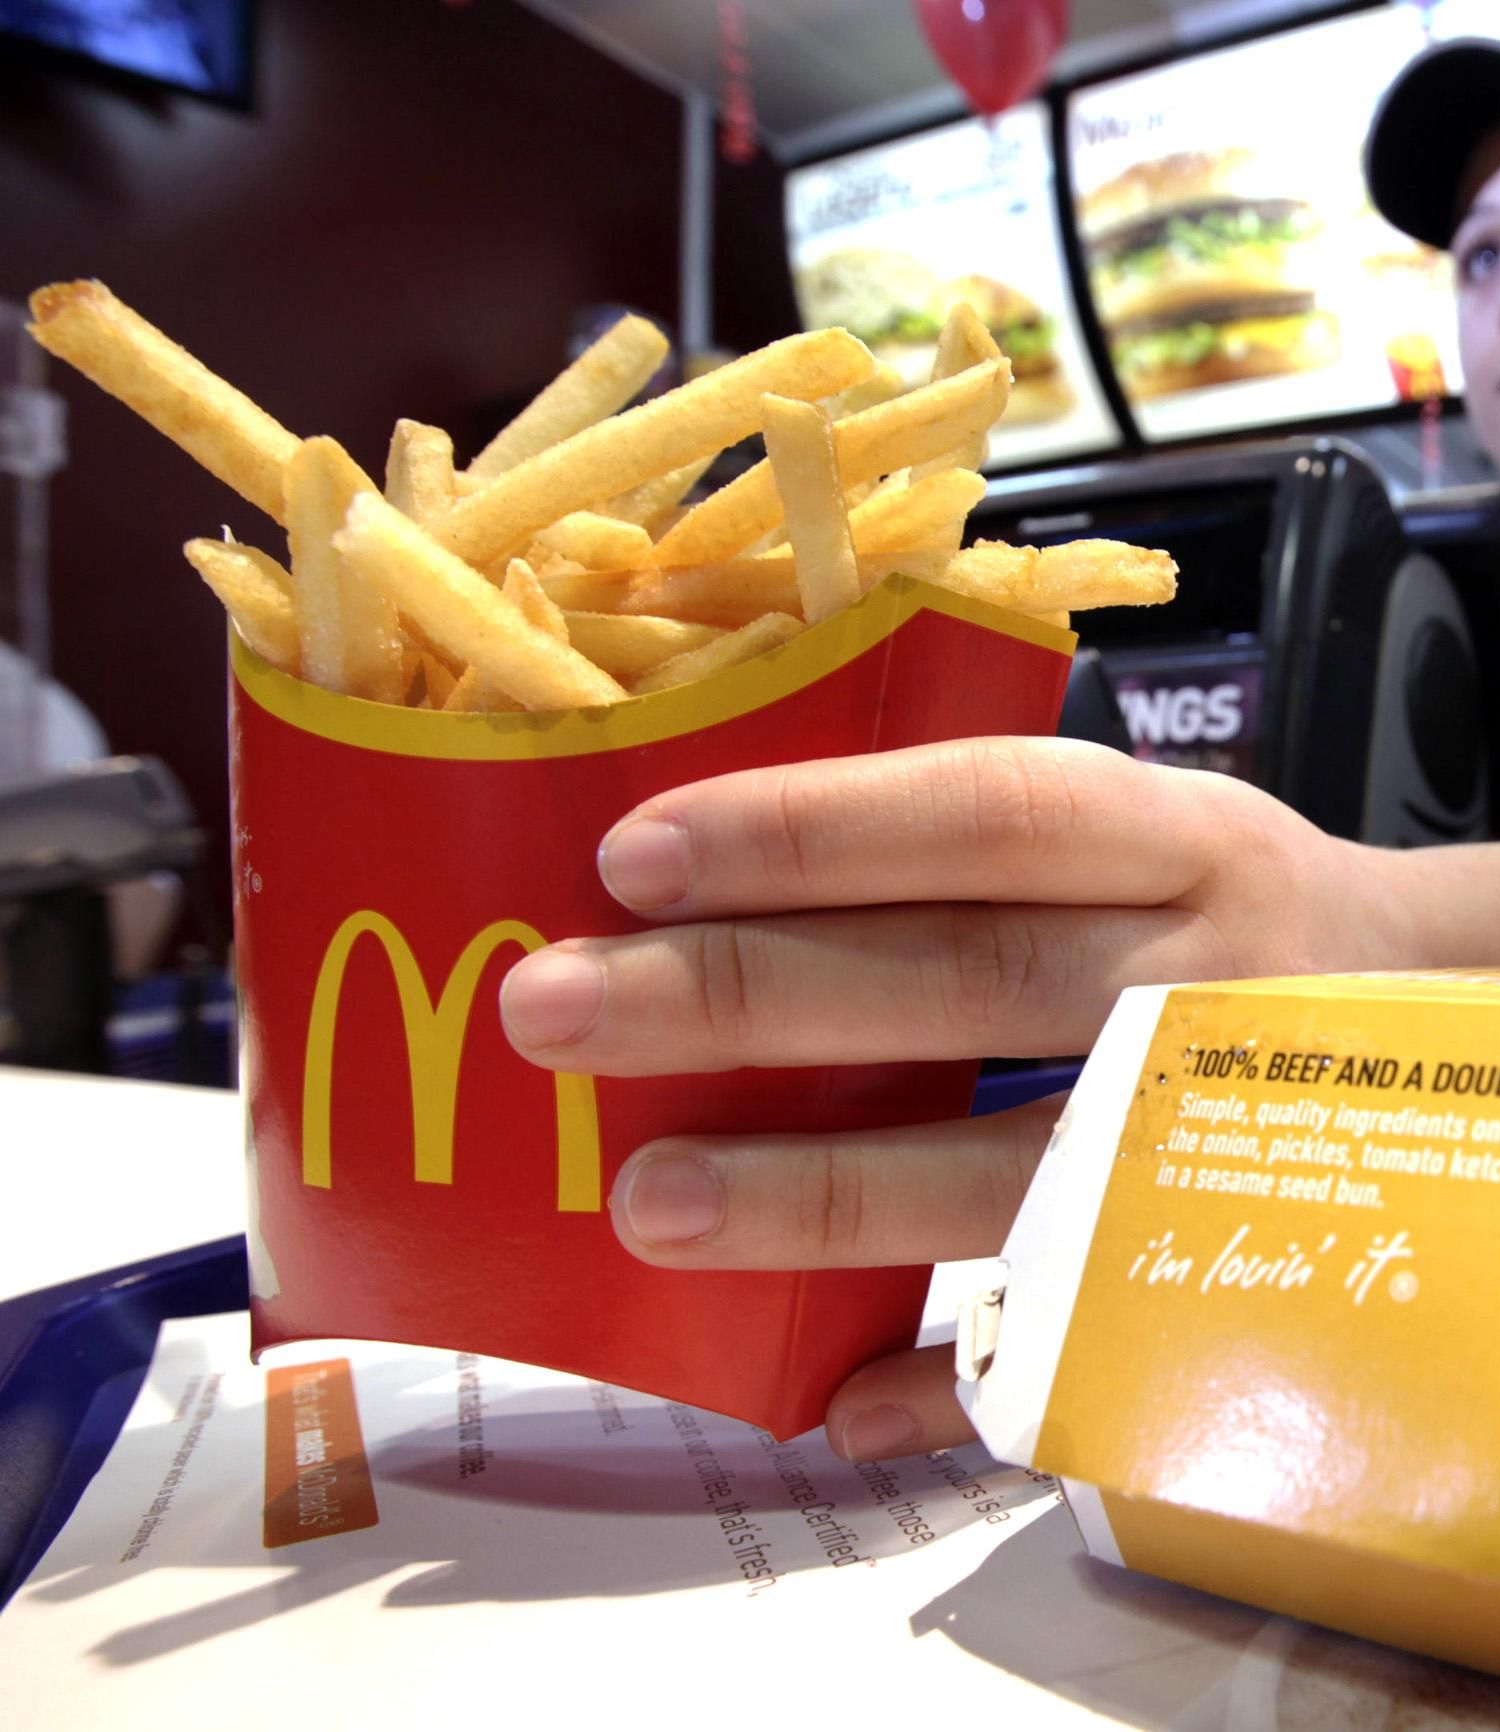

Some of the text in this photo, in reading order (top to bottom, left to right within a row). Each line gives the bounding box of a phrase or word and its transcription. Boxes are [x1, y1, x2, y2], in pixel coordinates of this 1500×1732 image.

[1193, 1048, 1259, 1081] 100%
[1265, 1052, 1333, 1084] BEEF
[1335, 1056, 1399, 1090] AND
[1402, 1060, 1424, 1092] A
[1177, 1092, 1250, 1127] Simple,
[1255, 1098, 1332, 1134] quality
[1333, 1103, 1466, 1142] ingredients
[1167, 1125, 1198, 1153] the
[1202, 1129, 1261, 1162] onion,
[1266, 1133, 1354, 1170] pickles,
[1361, 1142, 1446, 1176] tomato
[1155, 1161, 1385, 1210] in a sesame seed bun.
[1128, 1230, 1194, 1286] i'm
[171, 1450, 193, 1469] paper
[180, 1422, 205, 1450] recycled
[296, 1428, 334, 1467] makes
[162, 1467, 186, 1488] which
[693, 1459, 737, 1505] coffee,
[768, 1442, 817, 1504] Alliance
[928, 1462, 1011, 1526] yours is a
[142, 1495, 176, 1518] totally
[714, 1499, 763, 1546] that's
[854, 1460, 935, 1545] coffee, those
[130, 1515, 166, 1547] chlorine
[733, 1543, 786, 1598] fresh,
